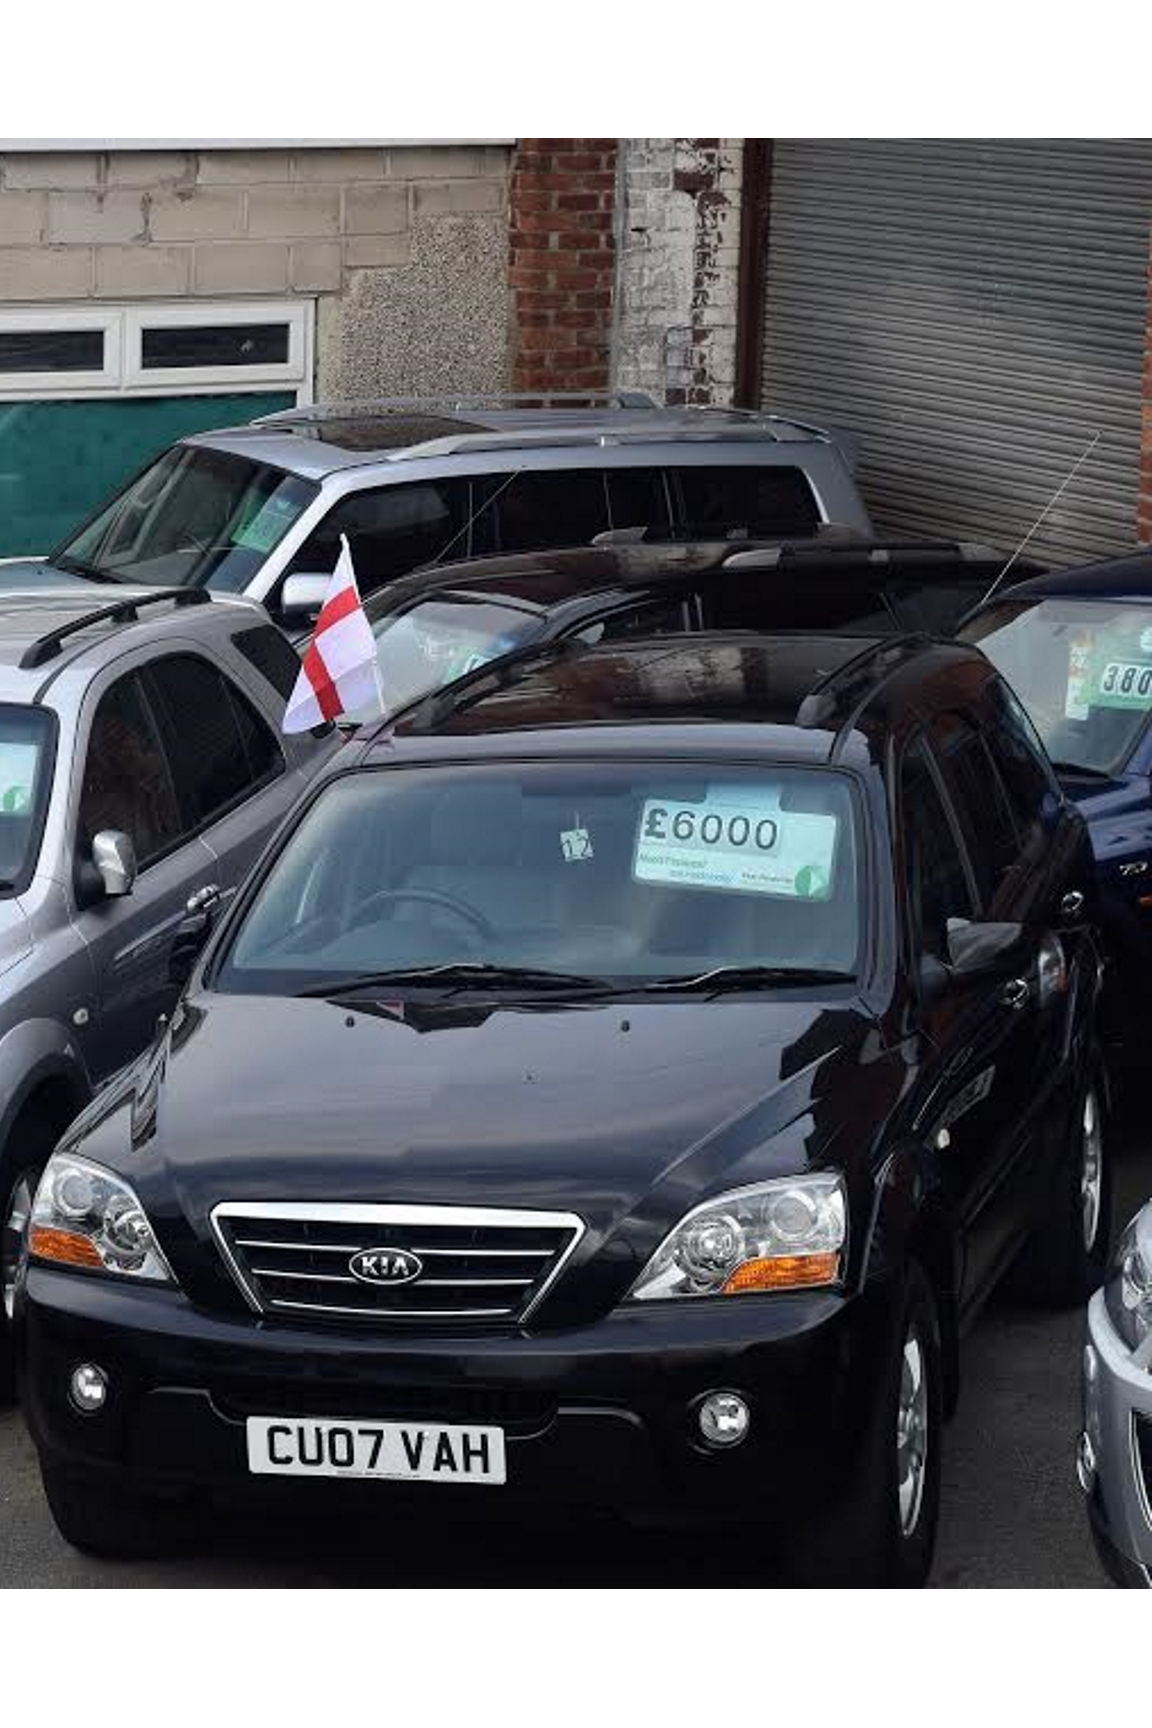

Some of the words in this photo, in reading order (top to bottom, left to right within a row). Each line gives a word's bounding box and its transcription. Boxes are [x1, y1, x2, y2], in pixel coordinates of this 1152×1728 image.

[644, 808, 778, 850] £6000
[361, 1256, 410, 1276] KIA
[266, 1425, 385, 1469] CU07
[400, 1430, 490, 1474] VAH
